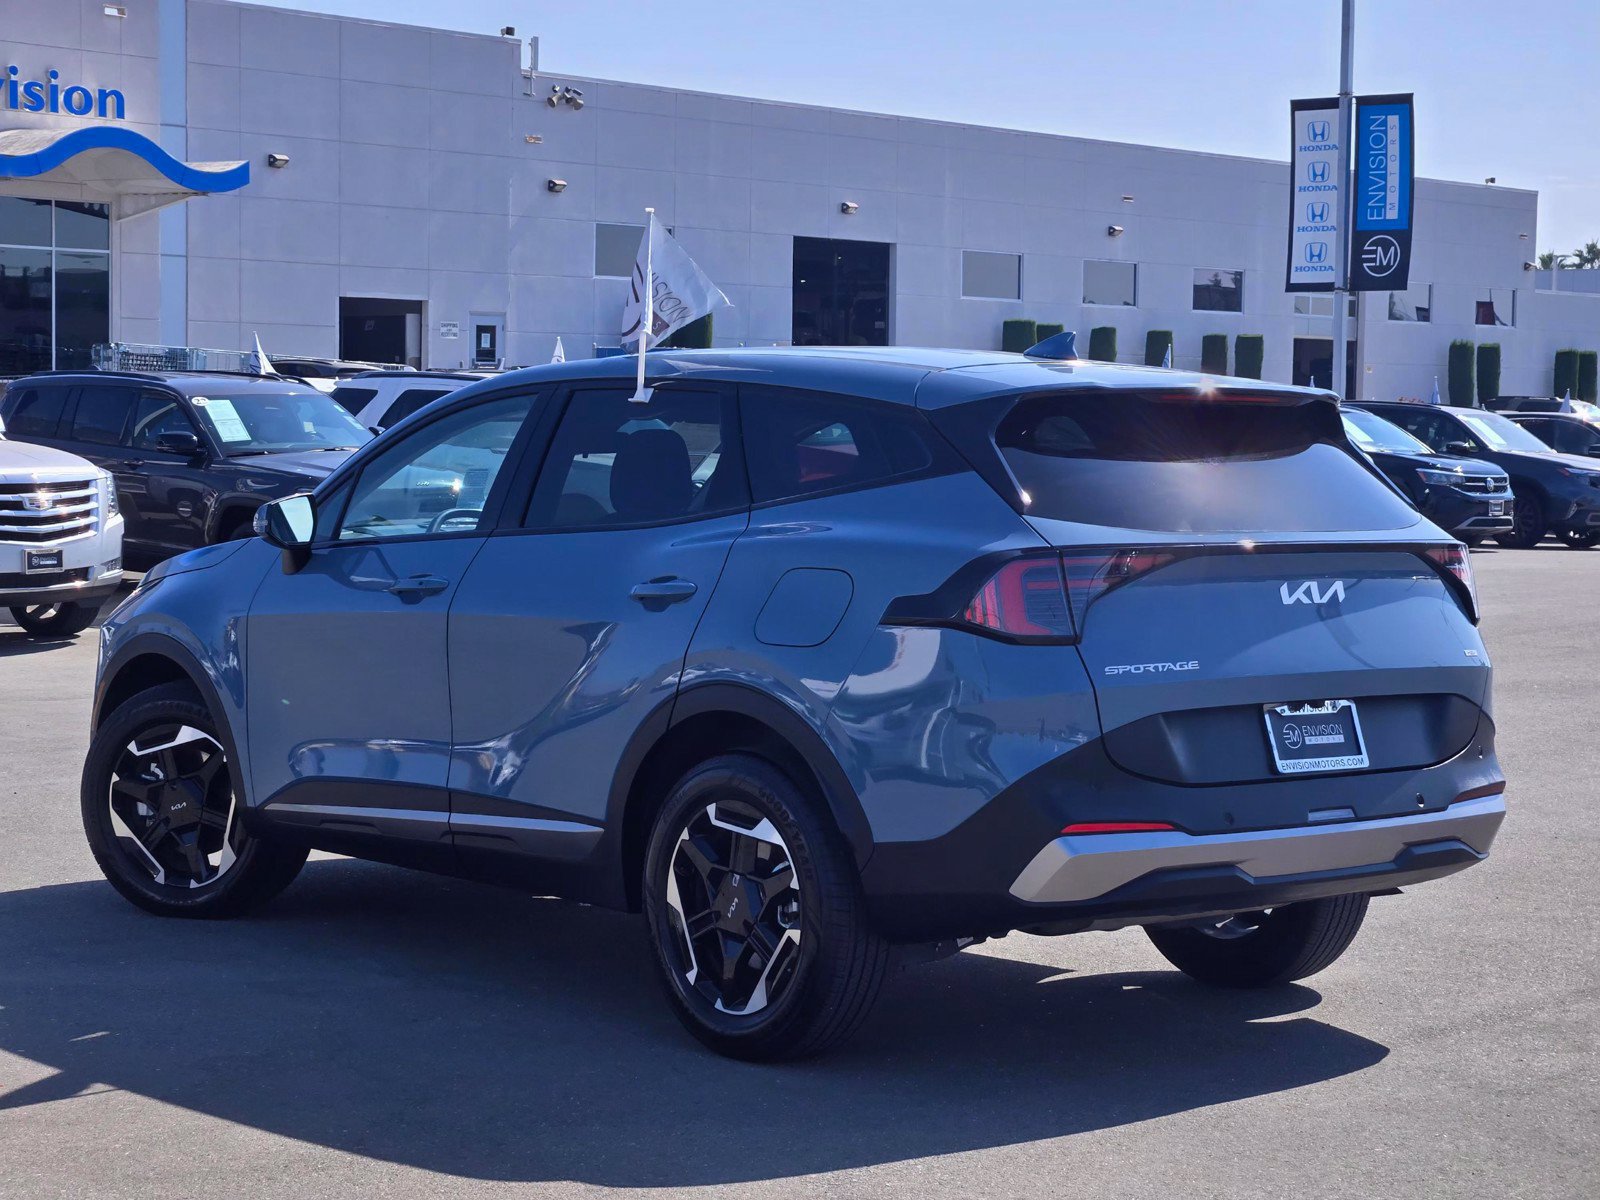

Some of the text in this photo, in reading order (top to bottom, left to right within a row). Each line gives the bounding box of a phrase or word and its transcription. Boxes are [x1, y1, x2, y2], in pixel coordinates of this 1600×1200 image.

[0, 65, 125, 120] ision
[1298, 143, 1339, 152] HONDA
[1367, 114, 1386, 221] ENVISION
[1389, 124, 1398, 211] MOTORS
[1297, 184, 1338, 193] HONDA
[1296, 225, 1337, 233] HONDA
[1294, 265, 1335, 273] HONDA
[1279, 580, 1346, 605] KIA
[1104, 660, 1200, 675] SPORTAGE
[1302, 724, 1343, 736] ENVISION
[1281, 758, 1364, 770] ENVISIONMOTORS.COM
